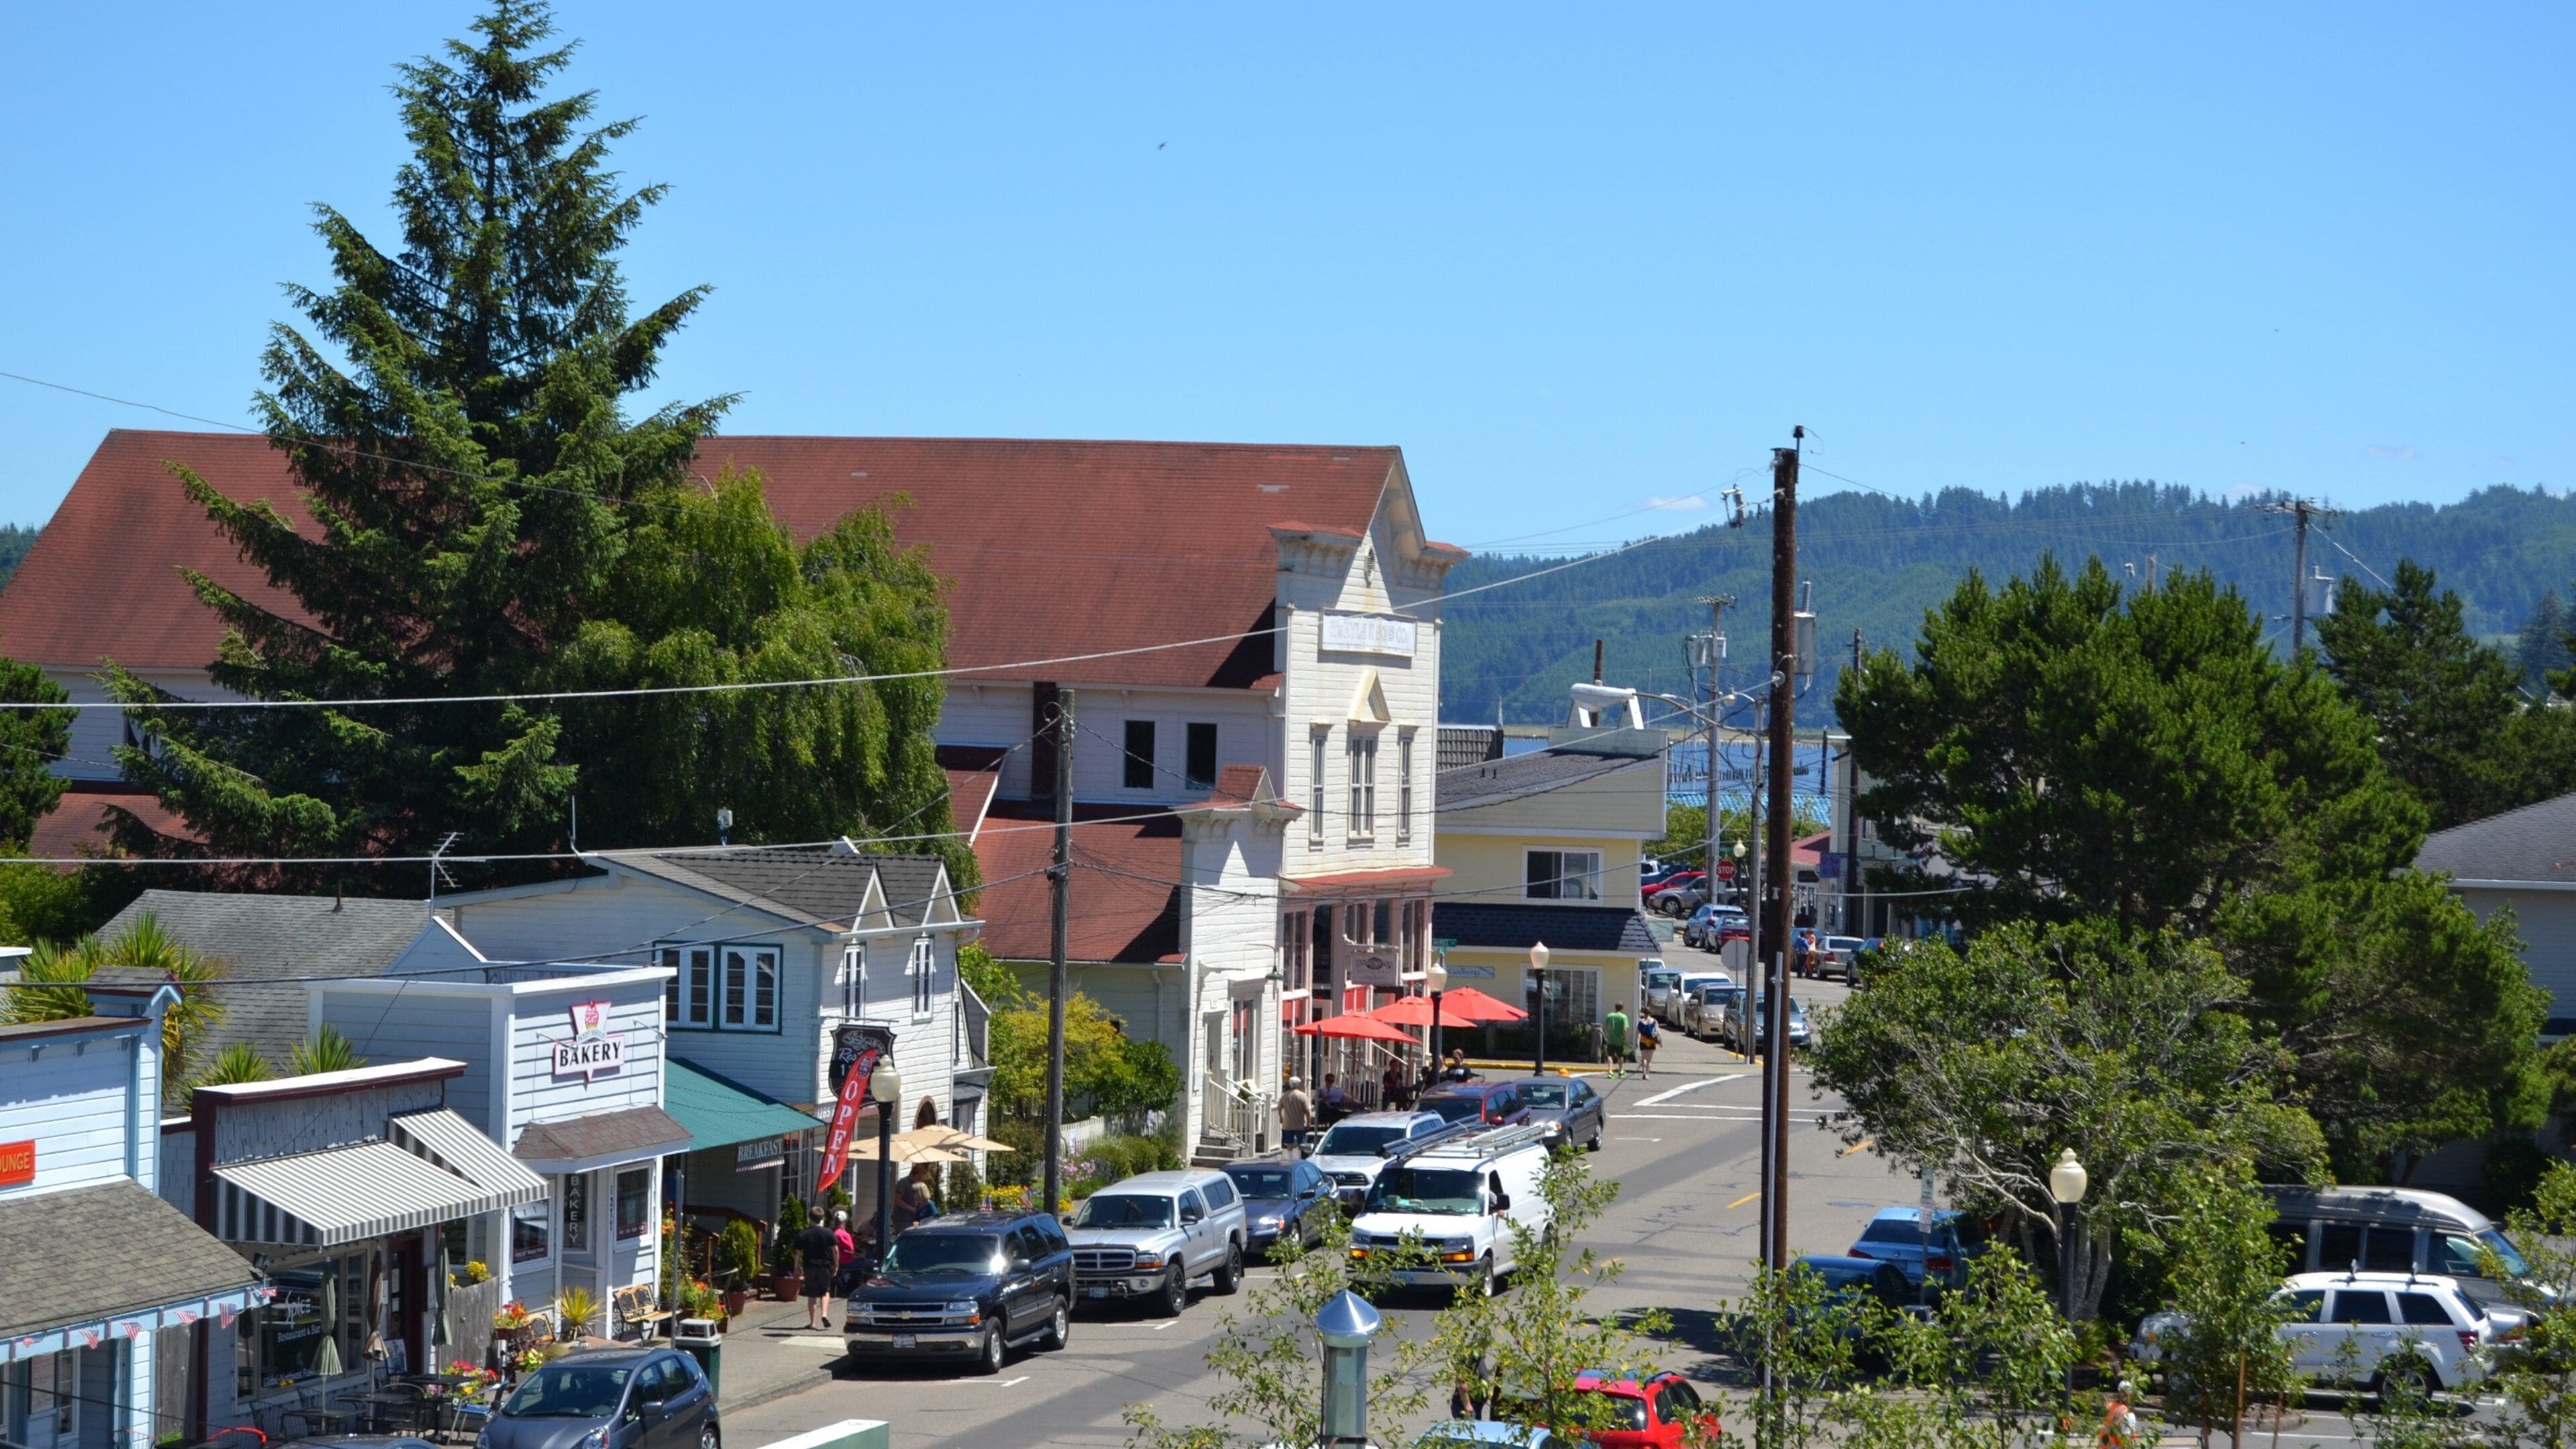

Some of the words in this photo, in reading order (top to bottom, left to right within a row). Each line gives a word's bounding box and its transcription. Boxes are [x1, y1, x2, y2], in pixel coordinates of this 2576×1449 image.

[1717, 866, 1735, 874] STOP
[559, 1041, 621, 1067] BAKERY
[824, 1081, 858, 1174] OPEN
[738, 1138, 784, 1162] BREAKFAST
[0, 1152, 31, 1173] UNGE
[569, 1176, 580, 1244] BAKERY
[278, 1327, 306, 1342] Restaurant
[311, 1324, 321, 1335] Bar
